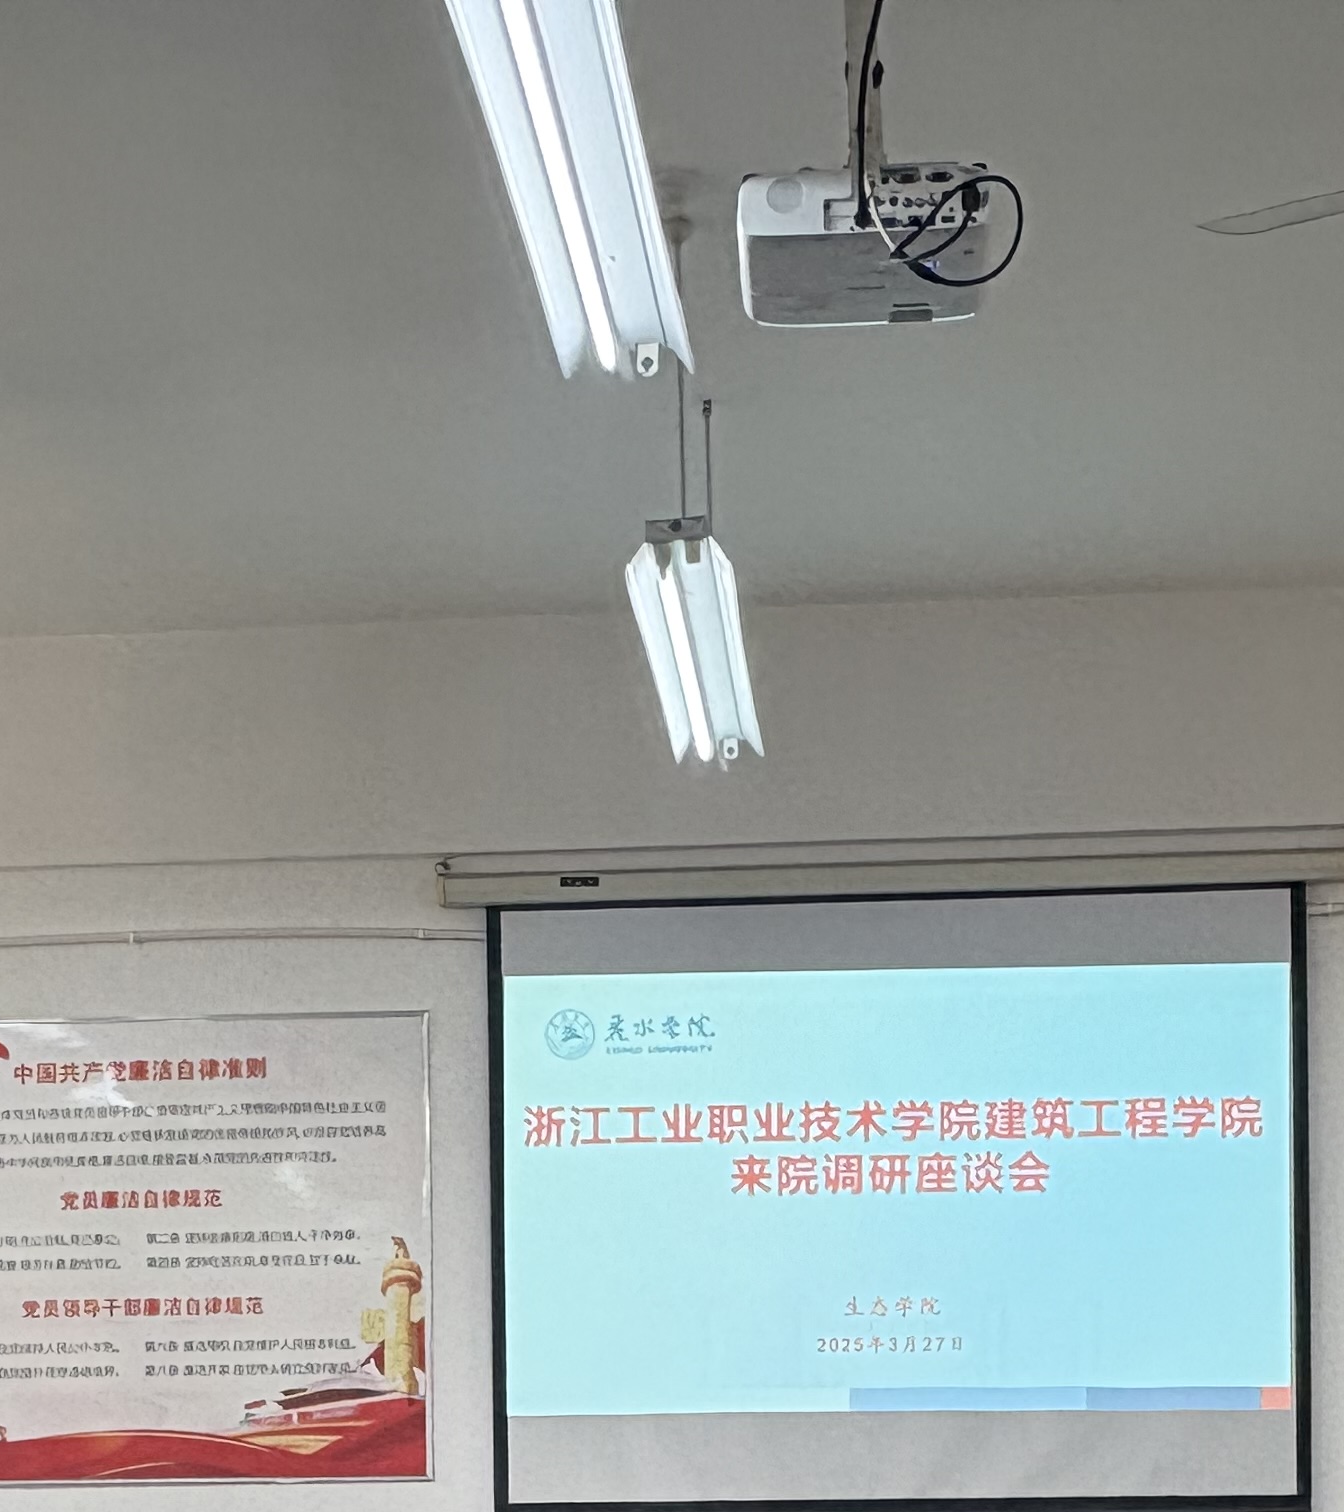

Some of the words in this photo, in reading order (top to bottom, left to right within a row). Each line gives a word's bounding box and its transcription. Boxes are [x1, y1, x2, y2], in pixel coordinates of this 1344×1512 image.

[13, 1056, 268, 1085] 中国共产党廉洁自律准则
[524, 1095, 1263, 1147] 浙江工业职业技术学院建筑工程学院
[731, 1150, 1050, 1197] 来院调研座谈会
[60, 1189, 223, 1211] 党员廉洁自律规范
[21, 1297, 264, 1319] 党员领导干部廉洁自律规范
[844, 1295, 941, 1318] 生态学院
[816, 1335, 963, 1354] 2025年3月27日
